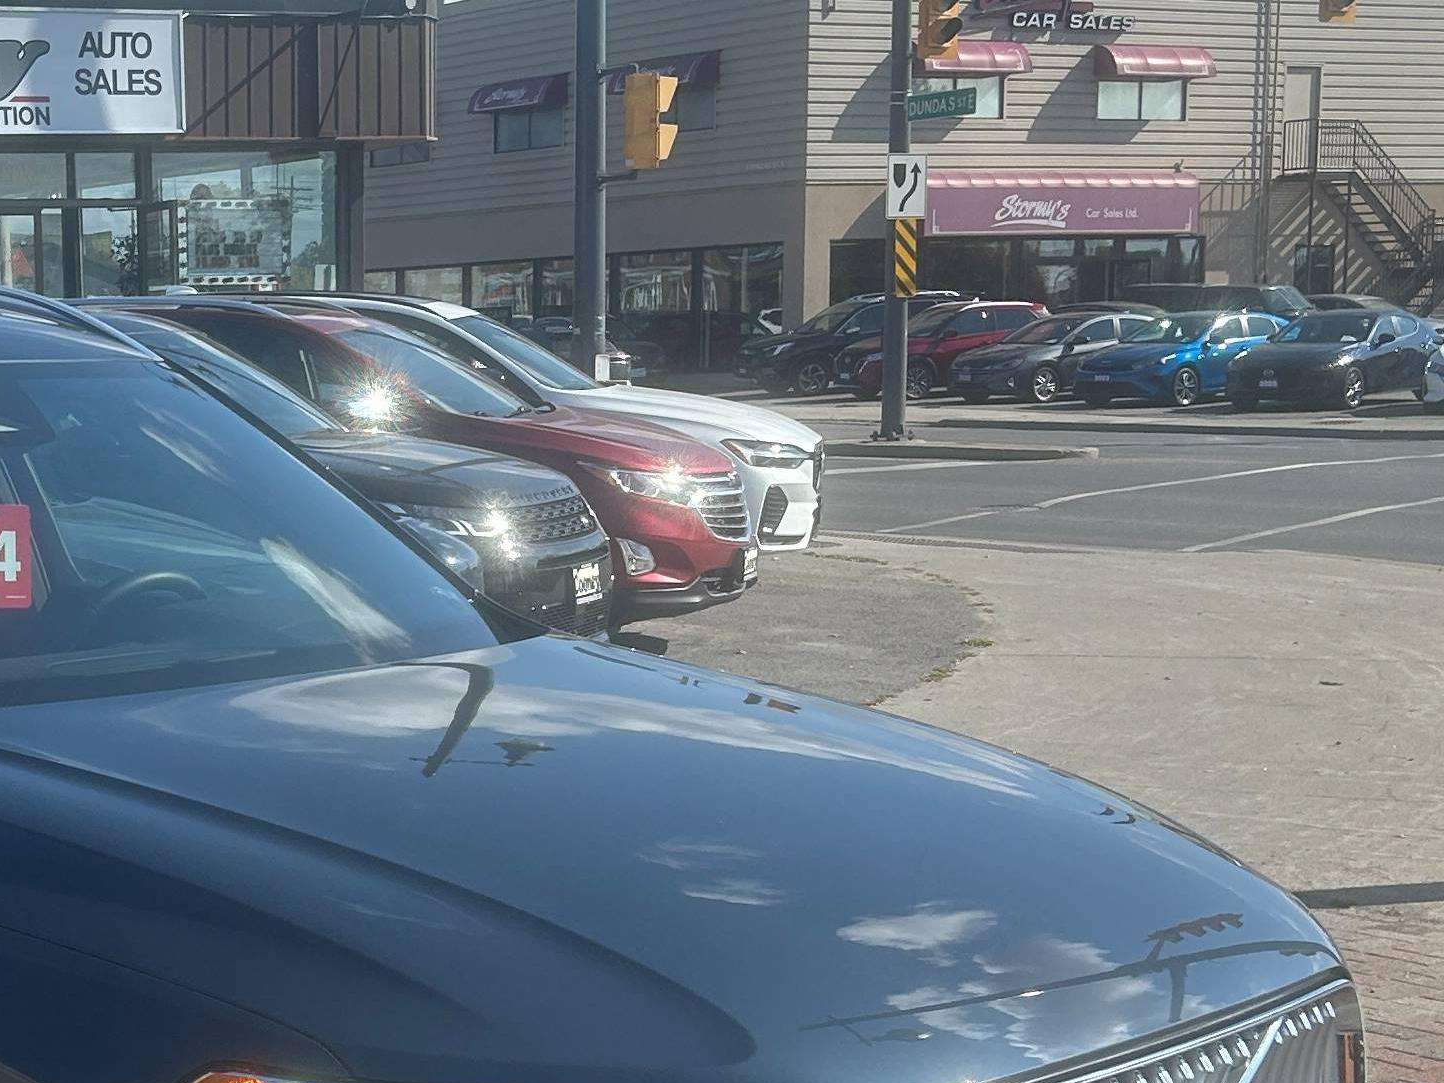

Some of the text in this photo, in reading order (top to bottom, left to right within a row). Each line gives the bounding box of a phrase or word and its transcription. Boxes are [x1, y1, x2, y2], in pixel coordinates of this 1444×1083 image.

[1012, 12, 1136, 32] CAR SALES
[78, 31, 153, 59] AUTO
[74, 68, 163, 96] SALES
[909, 97, 956, 117] DUNDAS
[1103, 208, 1123, 219] Sales
